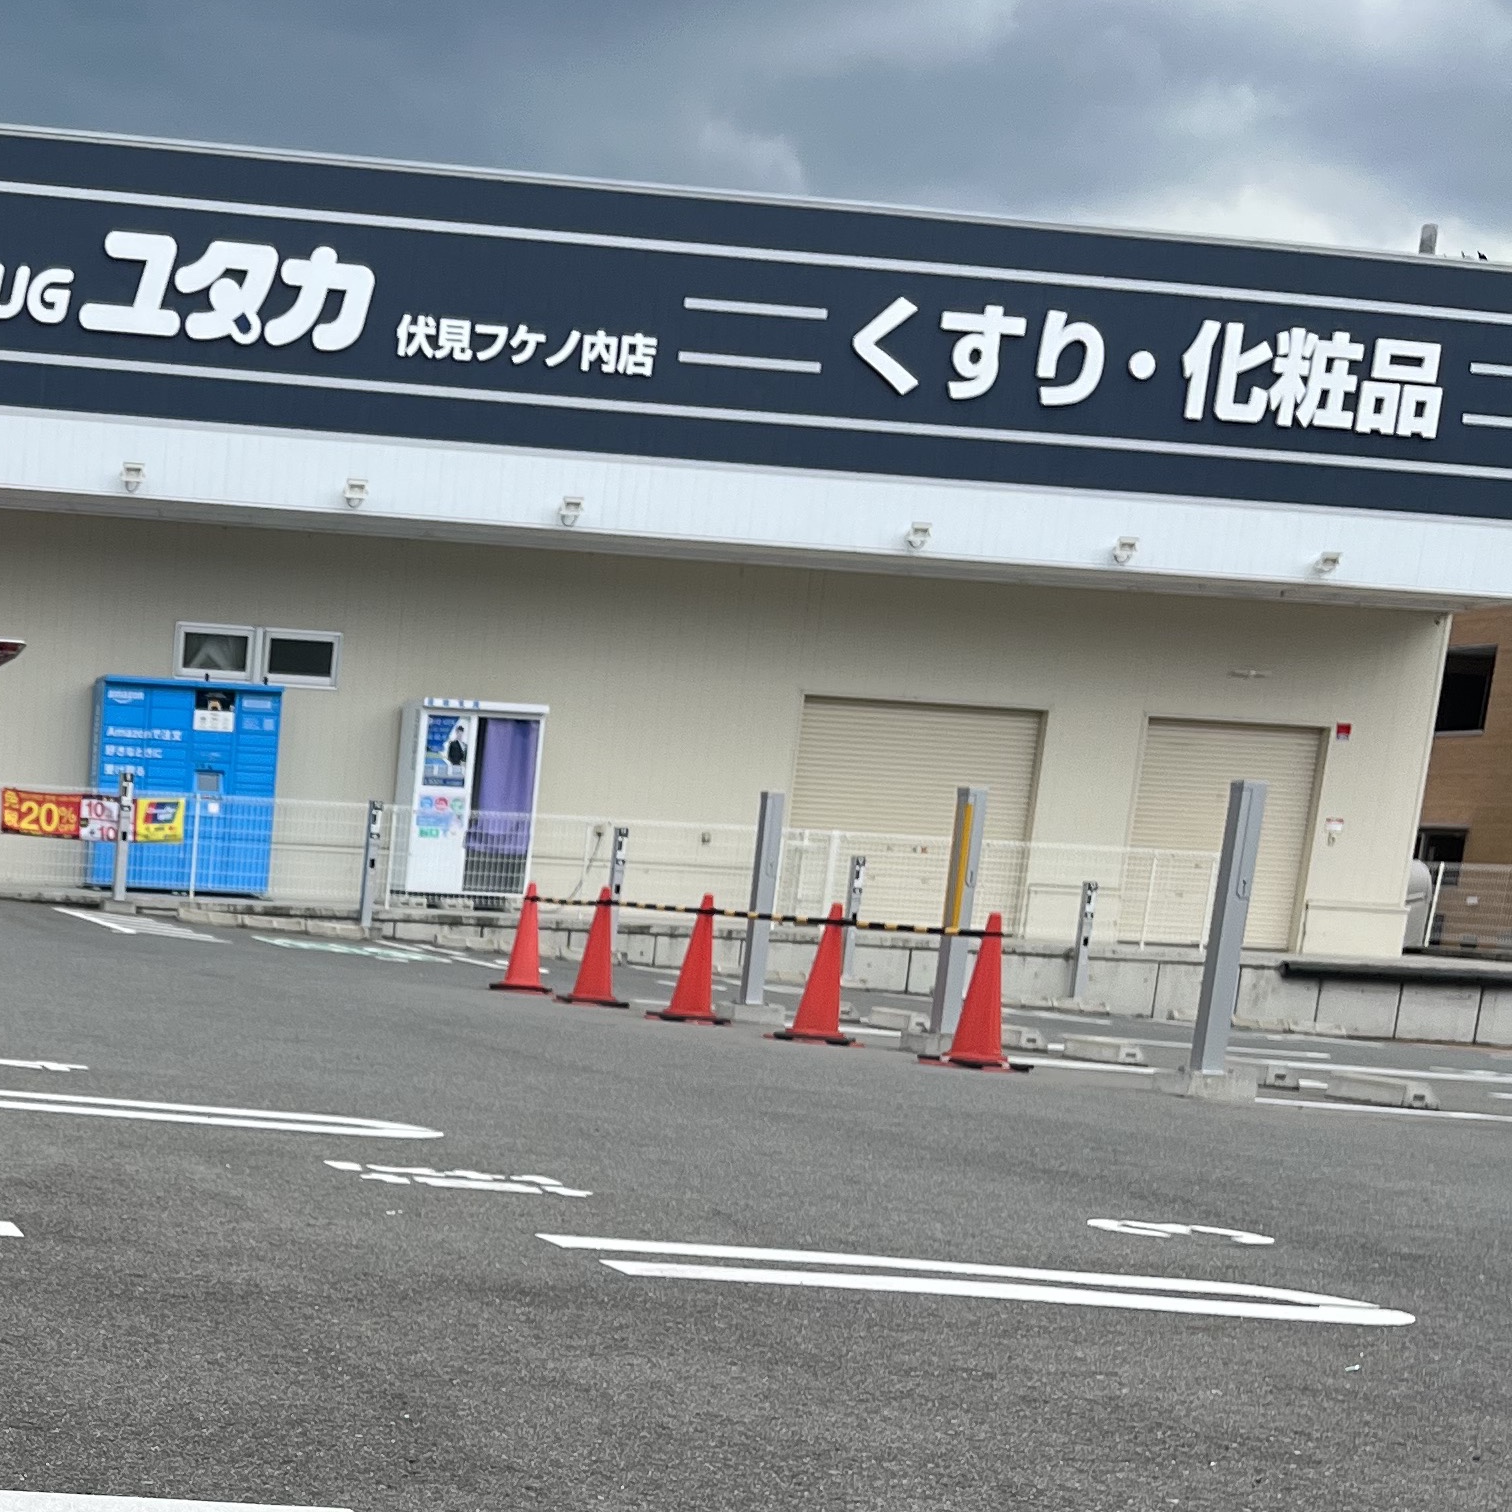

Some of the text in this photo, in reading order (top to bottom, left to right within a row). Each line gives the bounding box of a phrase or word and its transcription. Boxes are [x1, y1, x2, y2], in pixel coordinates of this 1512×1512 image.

[79, 229, 376, 352] ユタカ
[396, 313, 658, 377] 伏見フケノ内店
[852, 296, 1443, 439] くすり・化粧品
